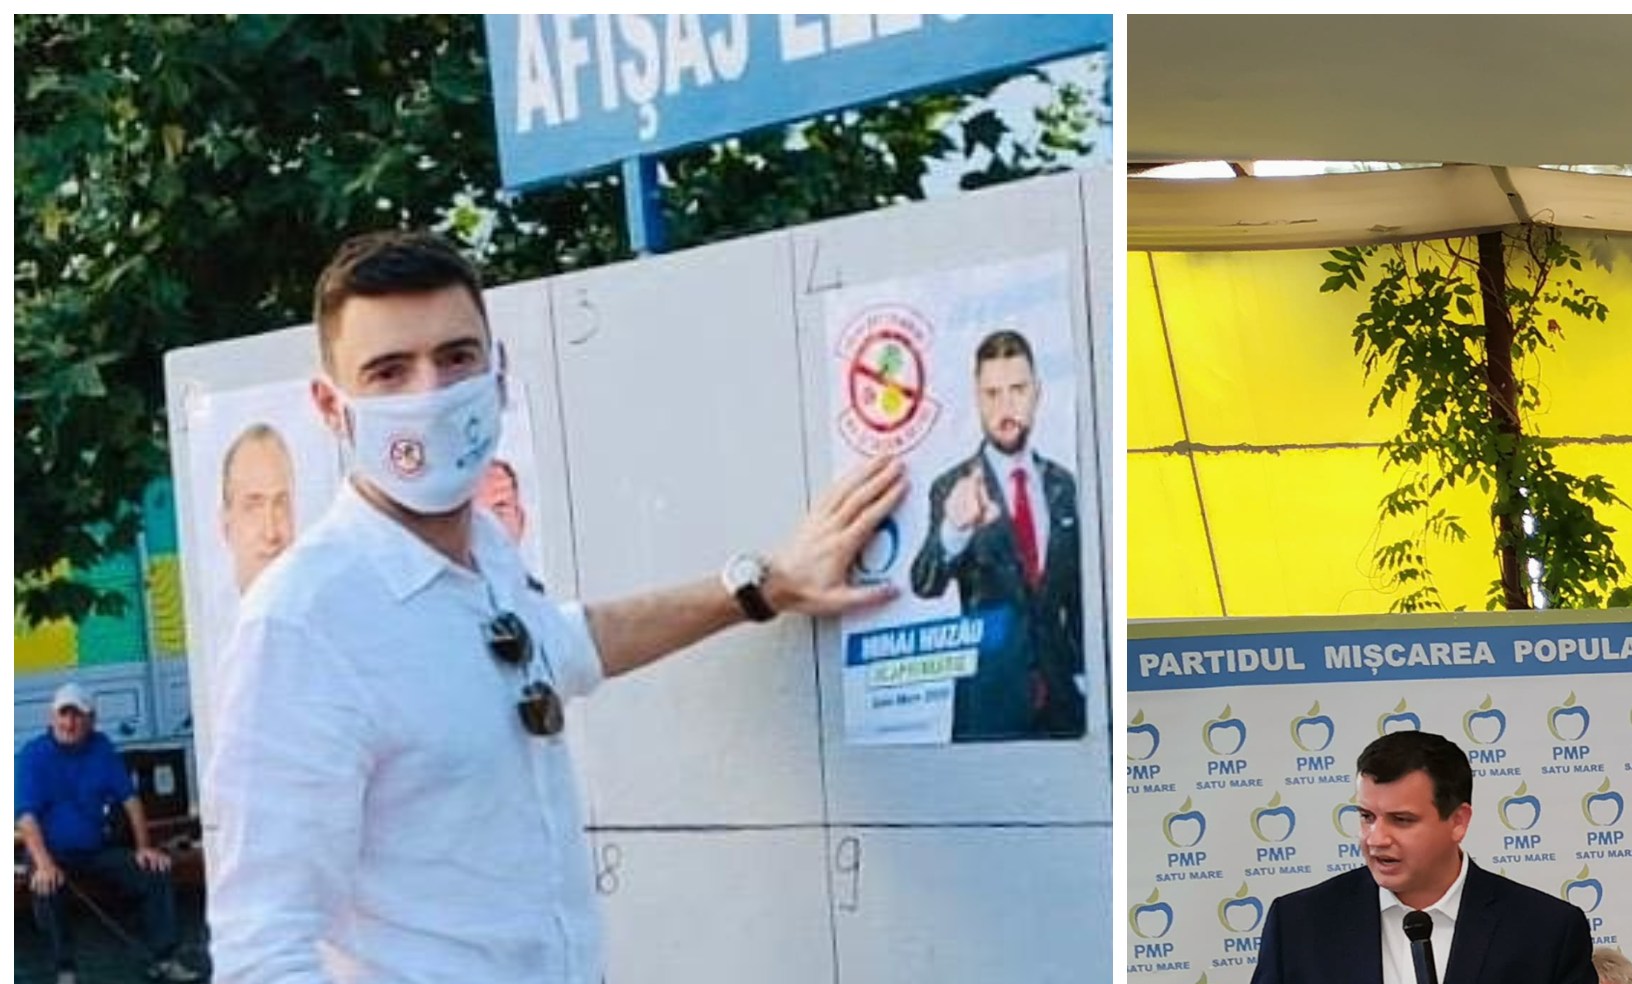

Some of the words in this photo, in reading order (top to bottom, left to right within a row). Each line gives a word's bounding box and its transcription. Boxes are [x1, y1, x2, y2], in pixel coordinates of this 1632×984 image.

[1139, 647, 1305, 677] PARTIDUL
[1324, 641, 1496, 676] MIȘCAREA
[1467, 748, 1507, 765] PMP
[1552, 745, 1590, 761] PMP
[1207, 759, 1248, 776] PMP
[1296, 755, 1336, 772] PMP
[1541, 765, 1571, 775] SATU
[1573, 763, 1605, 773] MARE
[1489, 767, 1522, 777] MARE
[1195, 780, 1226, 791] SATU
[1229, 778, 1264, 788] MARE
[1284, 776, 1315, 786] SATU
[1318, 774, 1351, 784] MARE
[1142, 783, 1177, 793] MARE
[1503, 834, 1542, 851] PMP
[1586, 830, 1624, 846] PMP
[1167, 851, 1207, 868] PMP
[1256, 846, 1297, 863] PMP
[1492, 854, 1522, 864] SATU
[1524, 852, 1557, 862] MARE
[1575, 850, 1605, 860] SATU
[597, 843, 621, 895] 8
[1244, 866, 1276, 877] SATU
[1278, 864, 1312, 874] MARE
[1155, 872, 1186, 883] SATU
[1188, 870, 1224, 880] MARE
[1134, 942, 1174, 959] PMP
[1155, 961, 1190, 971] MARE
[1211, 957, 1243, 968] SATU
